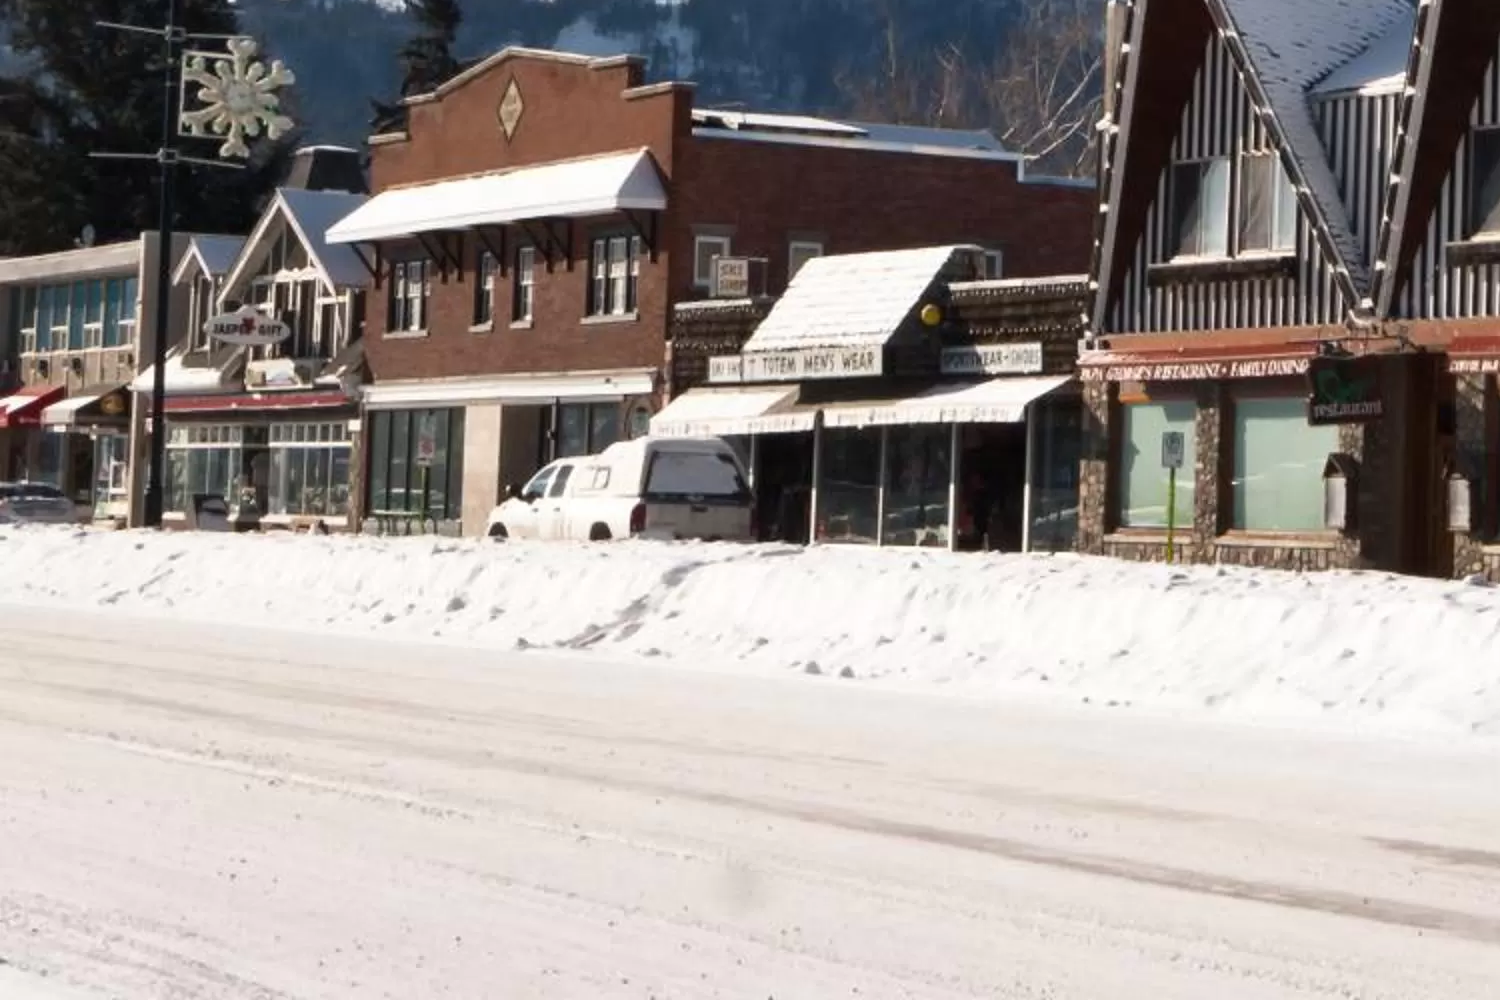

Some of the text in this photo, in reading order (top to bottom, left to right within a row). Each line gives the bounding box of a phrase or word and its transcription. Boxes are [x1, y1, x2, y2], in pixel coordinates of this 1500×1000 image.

[762, 357, 796, 375] TOTEM
[803, 354, 835, 373] MEN'S
[842, 351, 875, 371] WEAR
